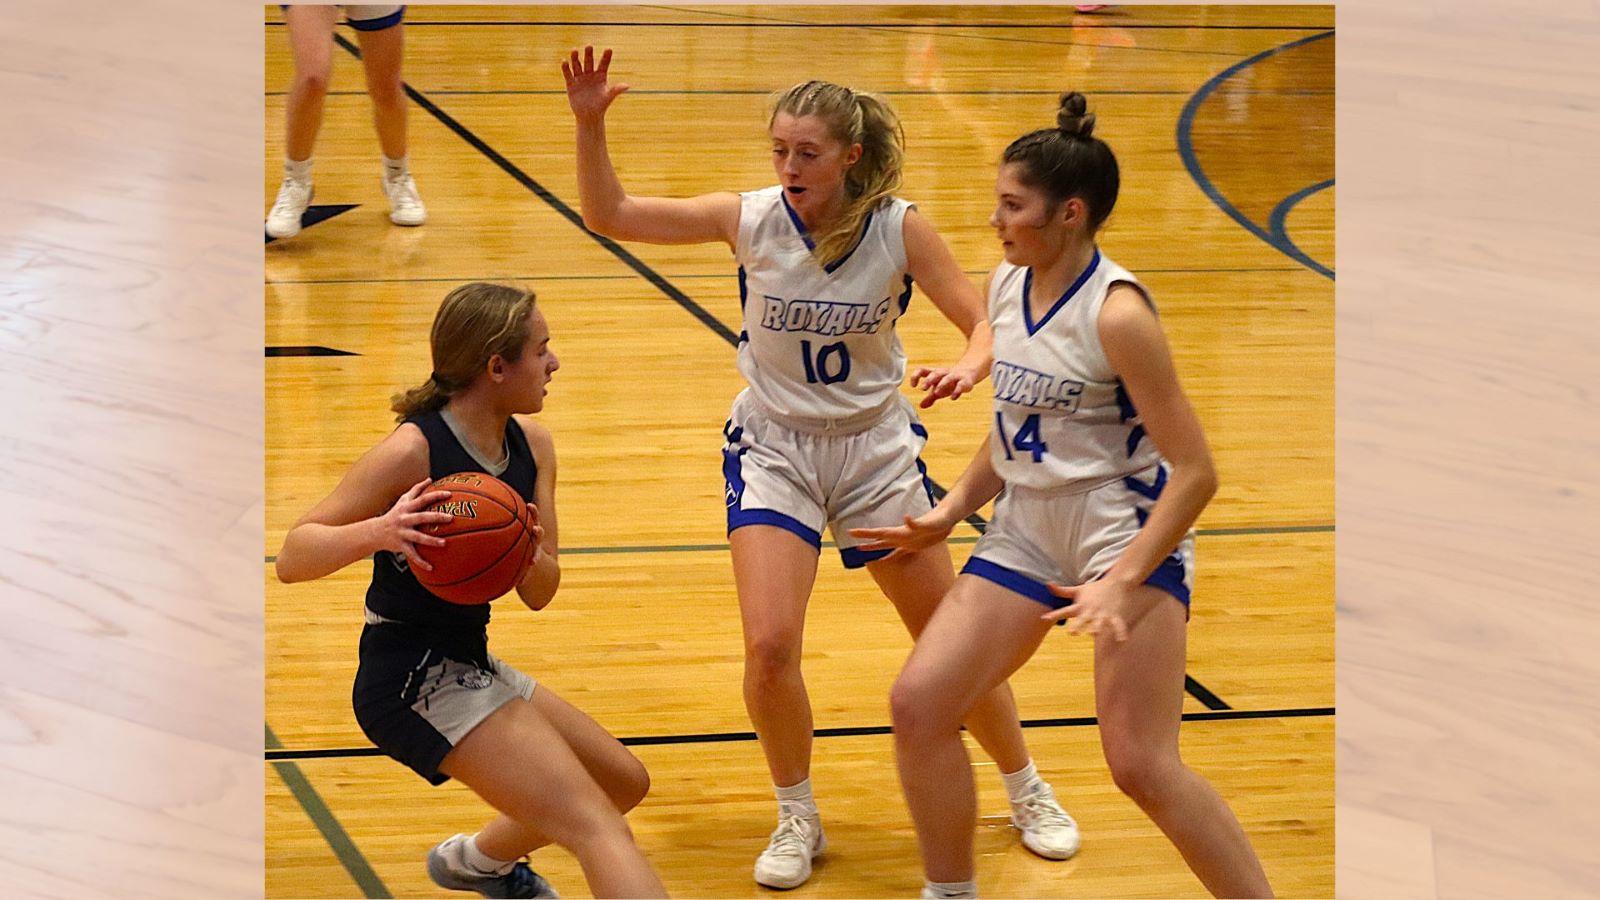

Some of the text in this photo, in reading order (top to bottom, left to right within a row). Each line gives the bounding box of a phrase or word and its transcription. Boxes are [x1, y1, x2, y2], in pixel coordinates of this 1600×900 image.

[761, 295, 891, 336] ROYALS
[801, 340, 850, 385] 10
[993, 361, 1085, 414] OYALS
[996, 411, 1049, 463] 14
